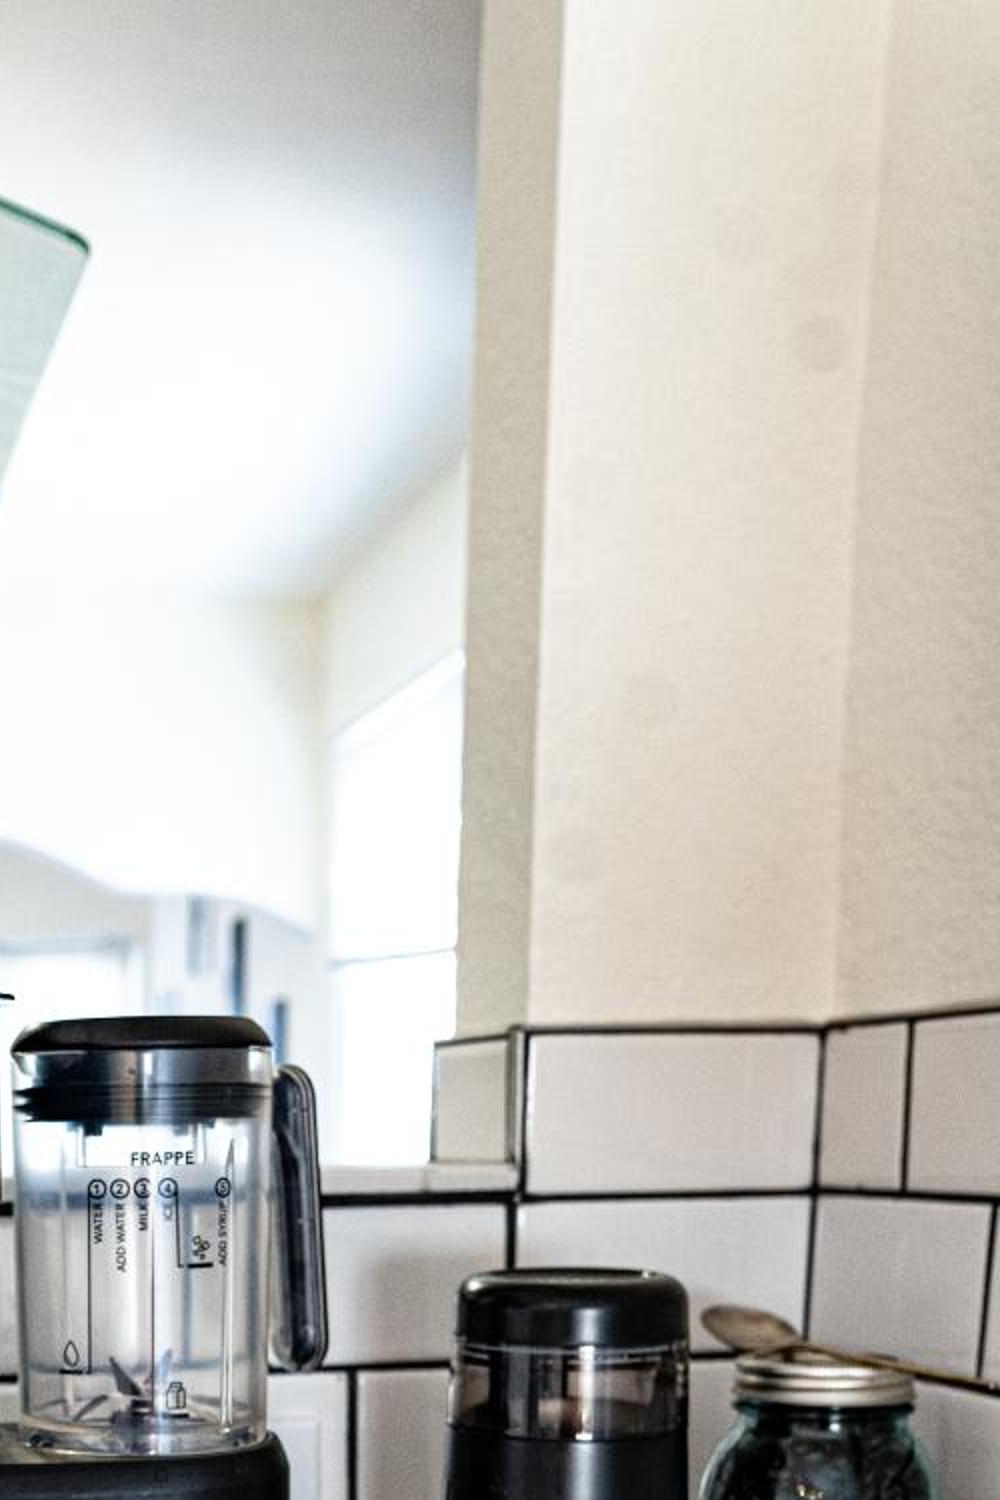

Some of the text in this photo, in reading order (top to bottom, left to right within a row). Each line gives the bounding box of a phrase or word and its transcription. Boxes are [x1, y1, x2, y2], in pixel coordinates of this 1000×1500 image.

[130, 1151, 196, 1167] FRAPPE
[93, 1203, 103, 1244] WATER
[138, 1203, 148, 1231] MILK
[115, 1203, 126, 1272] ADD WATER
[217, 1241, 229, 1267] ADD
